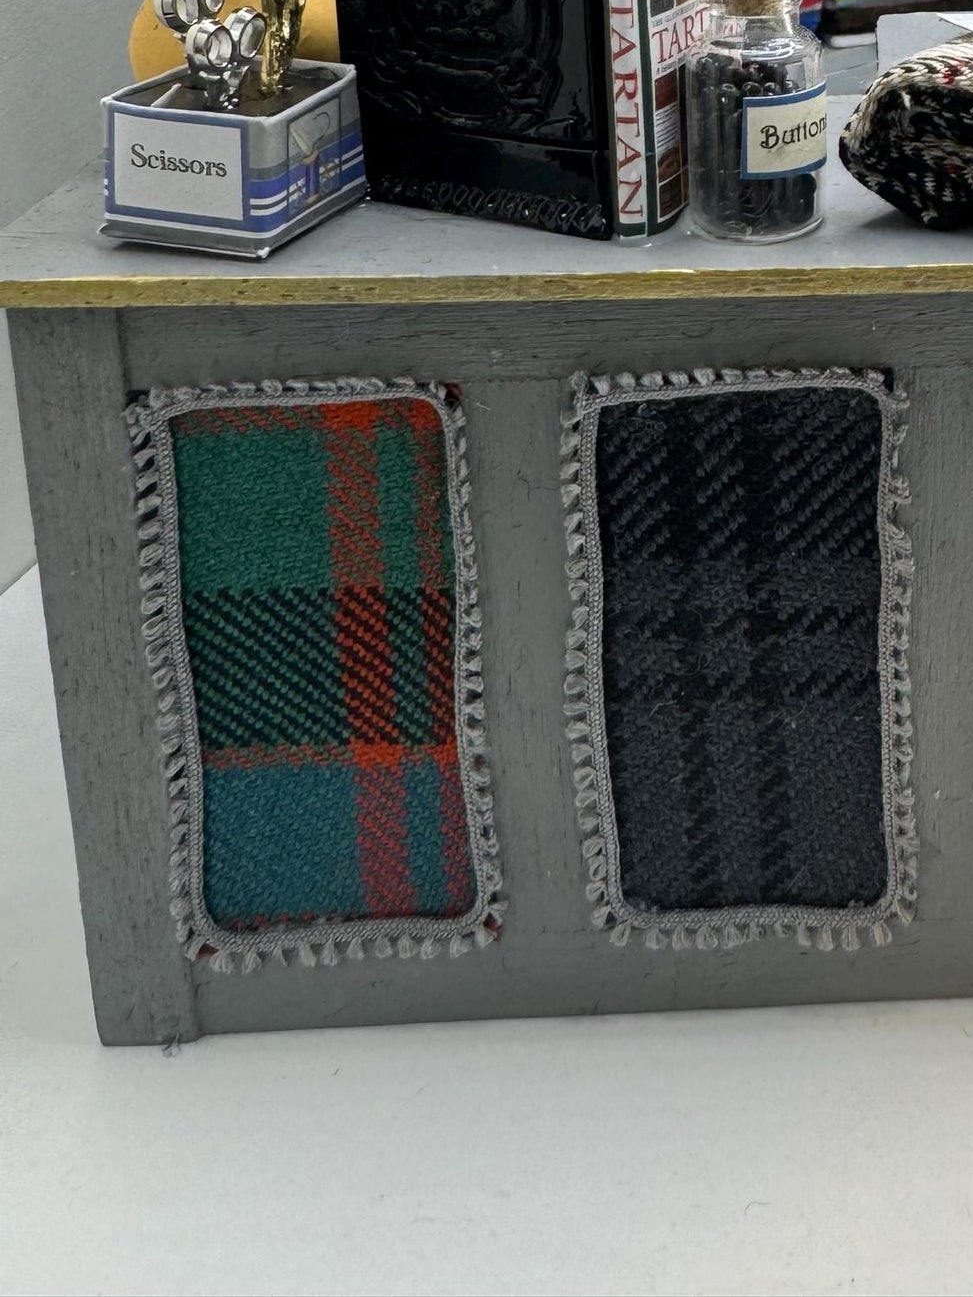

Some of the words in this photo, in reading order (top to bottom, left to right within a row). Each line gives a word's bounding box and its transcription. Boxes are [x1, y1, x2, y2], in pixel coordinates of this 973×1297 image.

[651, 6, 743, 64] TART
[760, 115, 827, 149] Button
[131, 143, 228, 178] Scissors
